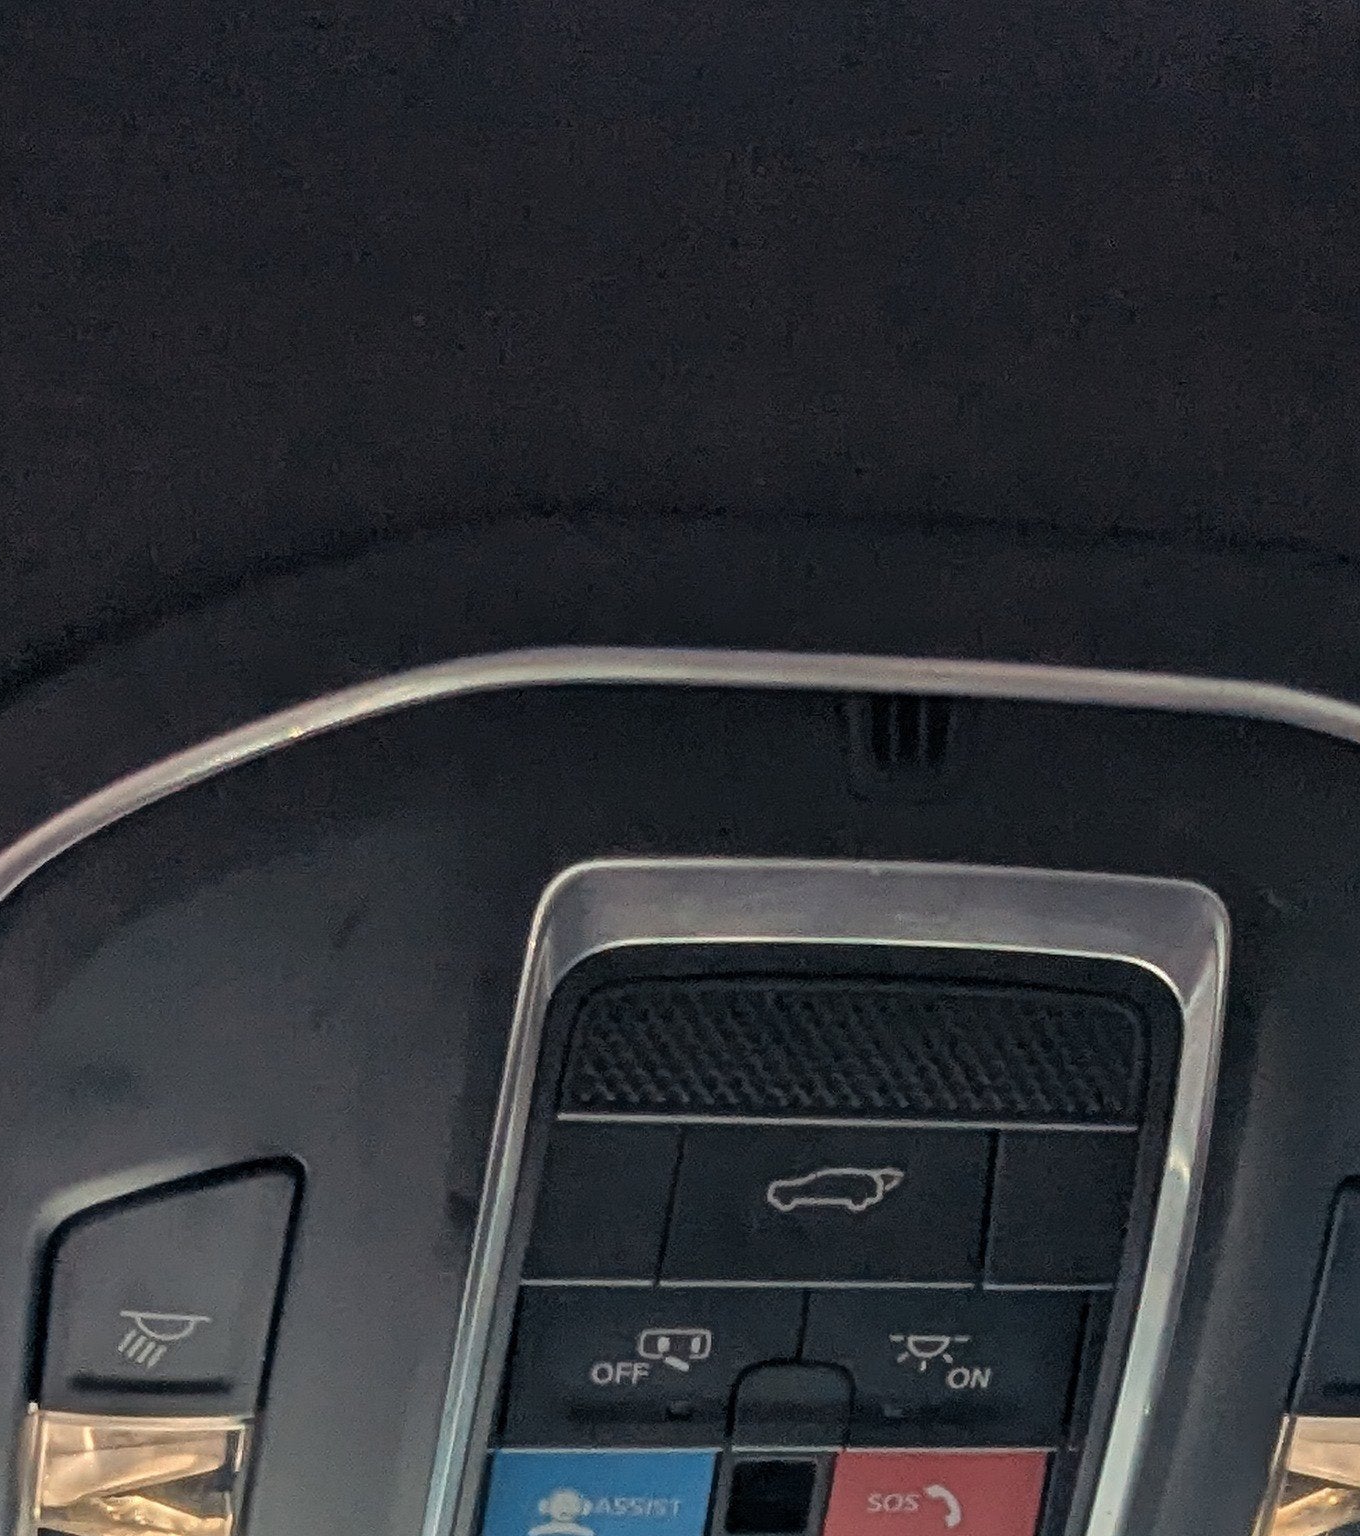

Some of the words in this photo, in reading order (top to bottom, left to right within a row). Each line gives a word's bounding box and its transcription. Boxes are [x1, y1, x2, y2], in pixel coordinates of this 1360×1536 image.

[590, 1361, 650, 1386] OFF
[946, 1367, 993, 1390] ON
[593, 1497, 682, 1519] ASSIST
[866, 1493, 920, 1513] SOS
